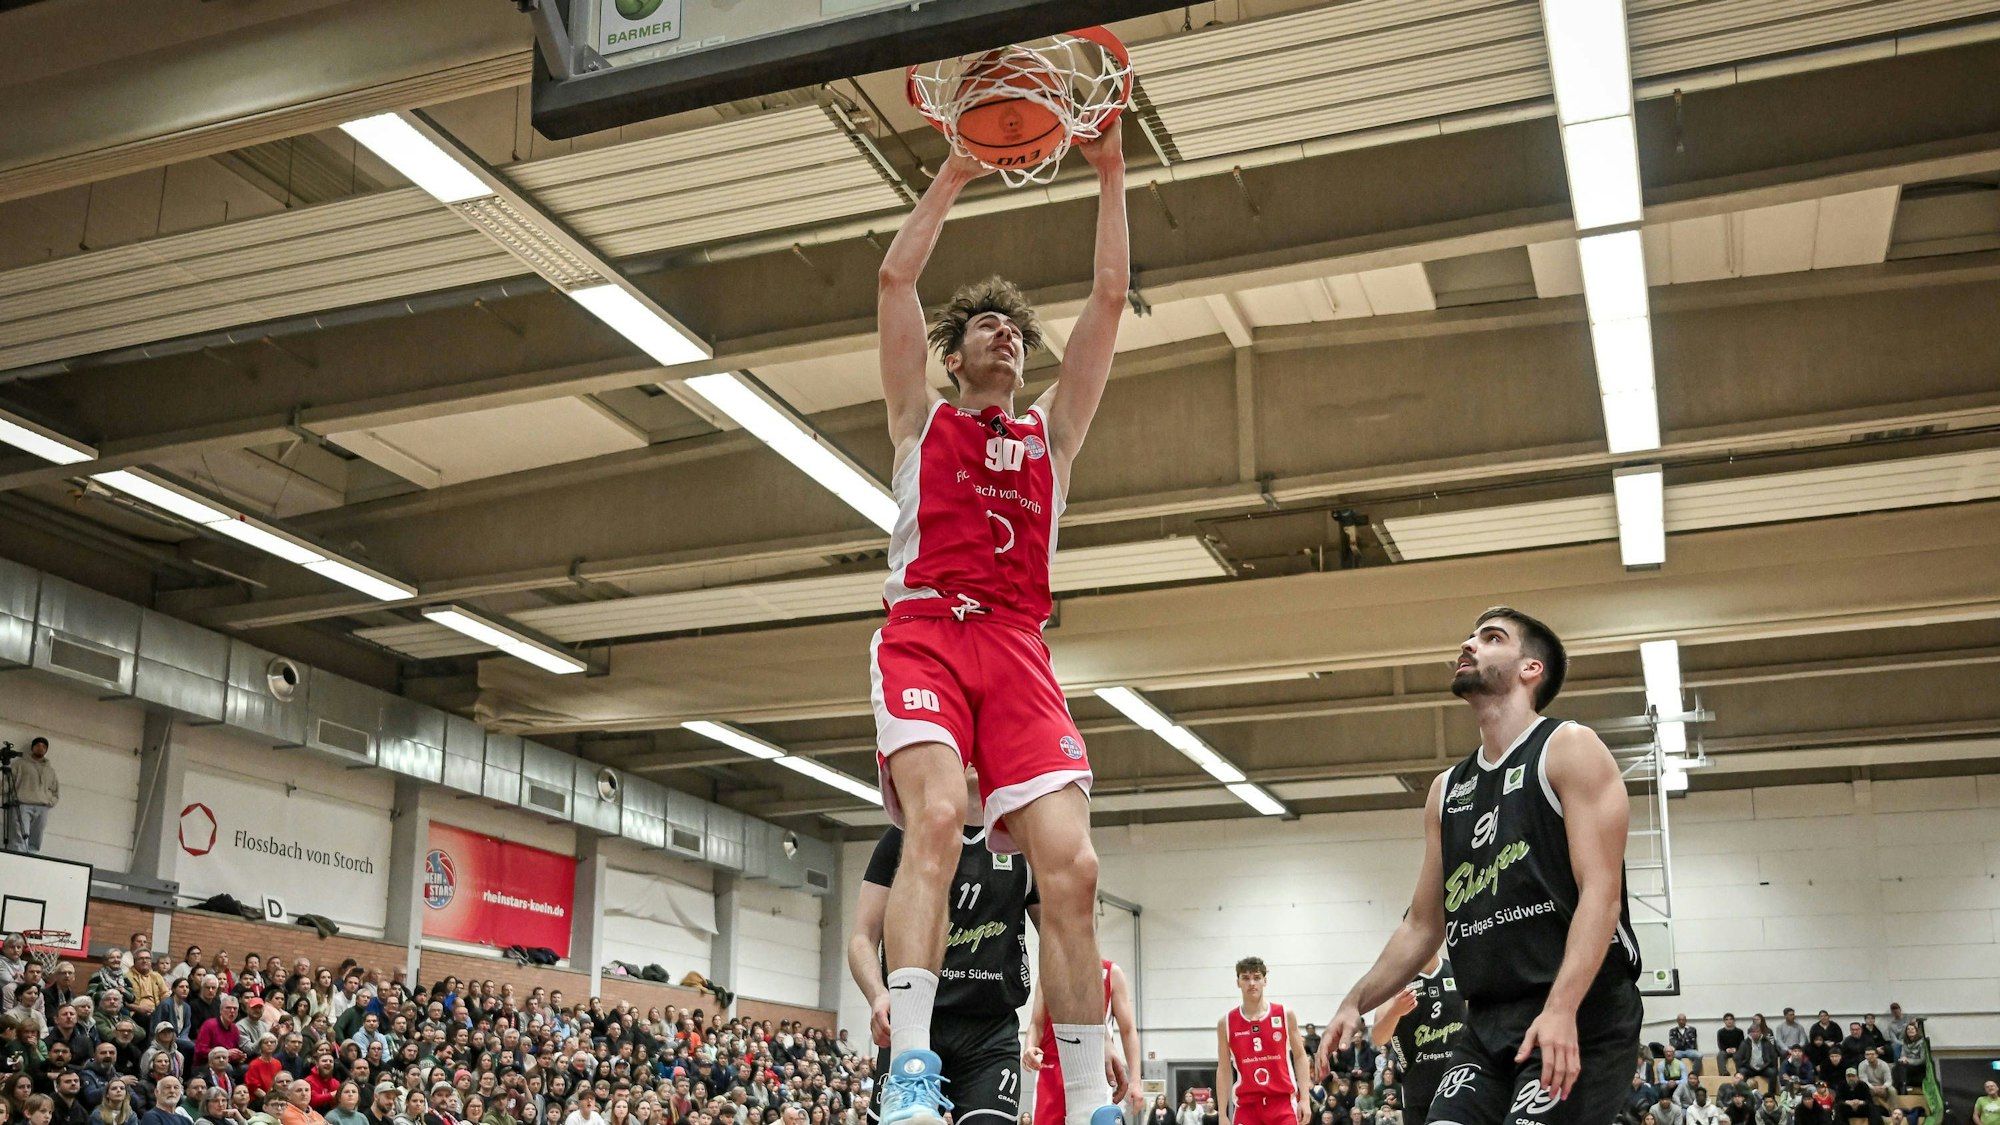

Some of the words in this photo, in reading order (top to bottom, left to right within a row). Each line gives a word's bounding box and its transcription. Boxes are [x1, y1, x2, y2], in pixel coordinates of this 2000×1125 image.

[607, 21, 672, 46] BARMER
[997, 149, 1041, 166] EVO
[985, 437, 1025, 472] 90
[1000, 488, 1018, 500] von
[902, 688, 941, 712] 90
[234, 830, 302, 860] Flossbach
[306, 848, 331, 866] von
[333, 851, 374, 874] Storch
[1445, 840, 1530, 913] Ehingen
[429, 884, 454, 897] STARS
[957, 882, 982, 910] 11
[267, 898, 283, 918] D
[1460, 919, 1494, 938] Erdgas
[1495, 900, 1556, 925] Südwest
[946, 921, 1007, 953] hingen
[968, 968, 1004, 980] Südwes
[1430, 1001, 1442, 1019] 3
[1253, 1037, 1263, 1052] 3
[1414, 1021, 1463, 1047] Ehingen
[1422, 1051, 1445, 1061] Erdgas
[998, 1067, 1018, 1095] 11
[997, 1094, 1016, 1106] CRAFT
[1510, 1079, 1562, 1115] 99
